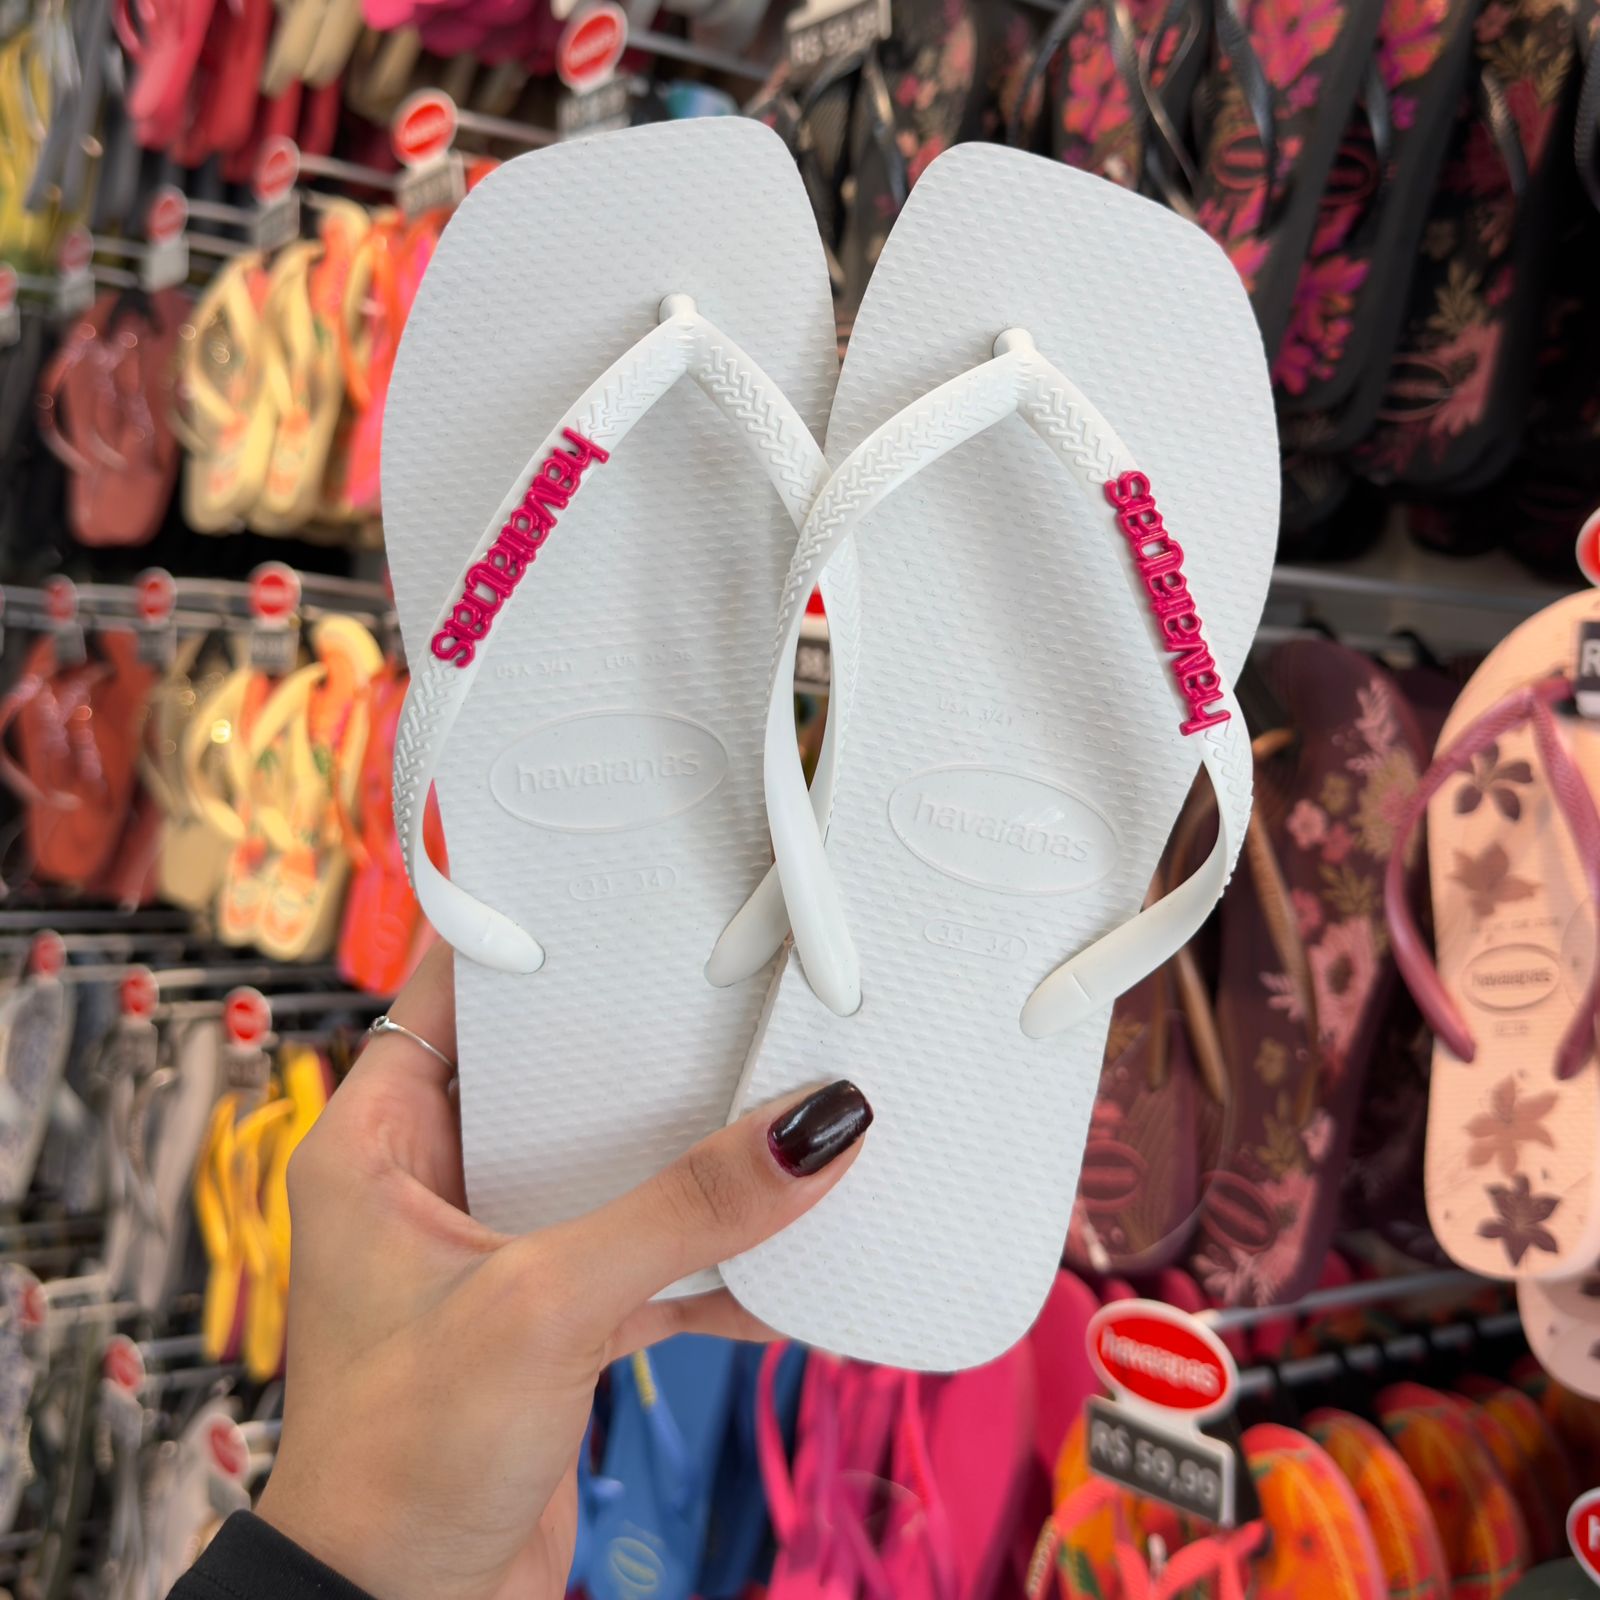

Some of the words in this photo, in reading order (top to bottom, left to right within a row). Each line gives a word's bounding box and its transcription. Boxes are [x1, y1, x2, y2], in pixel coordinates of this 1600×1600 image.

[431, 427, 610, 668] havaianas
[1103, 470, 1231, 736] havaianas
[513, 751, 700, 794] havaianas
[912, 792, 1096, 863] havaianas
[1101, 1325, 1222, 1398] havaianas
